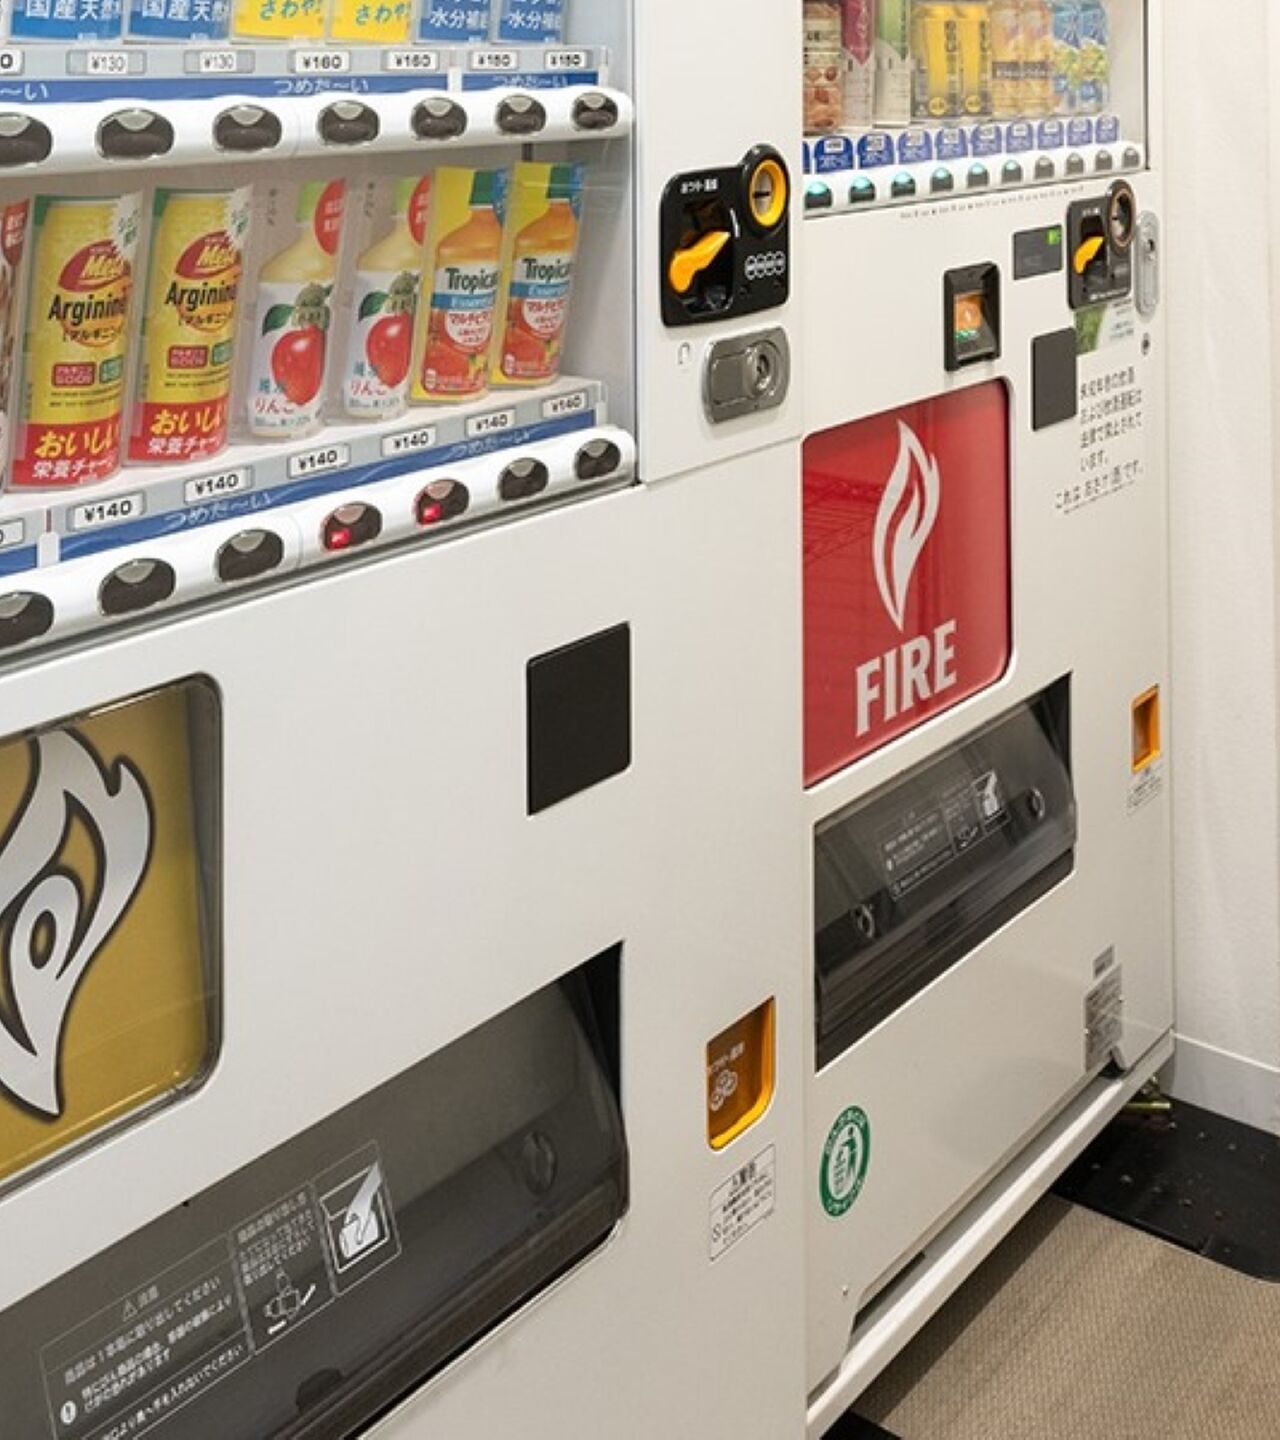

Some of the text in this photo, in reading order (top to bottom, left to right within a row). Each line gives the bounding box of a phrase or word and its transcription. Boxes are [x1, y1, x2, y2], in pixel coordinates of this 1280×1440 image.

[91, 54, 126, 73] ¥130
[203, 53, 235, 70] ¥130
[301, 54, 342, 70] ¥160
[474, 414, 509, 431] ¥140
[392, 431, 430, 449] ¥140
[297, 450, 338, 471] ¥140
[194, 474, 239, 495] ¥140
[84, 500, 132, 521] ¥140
[855, 618, 958, 737] FIRE
